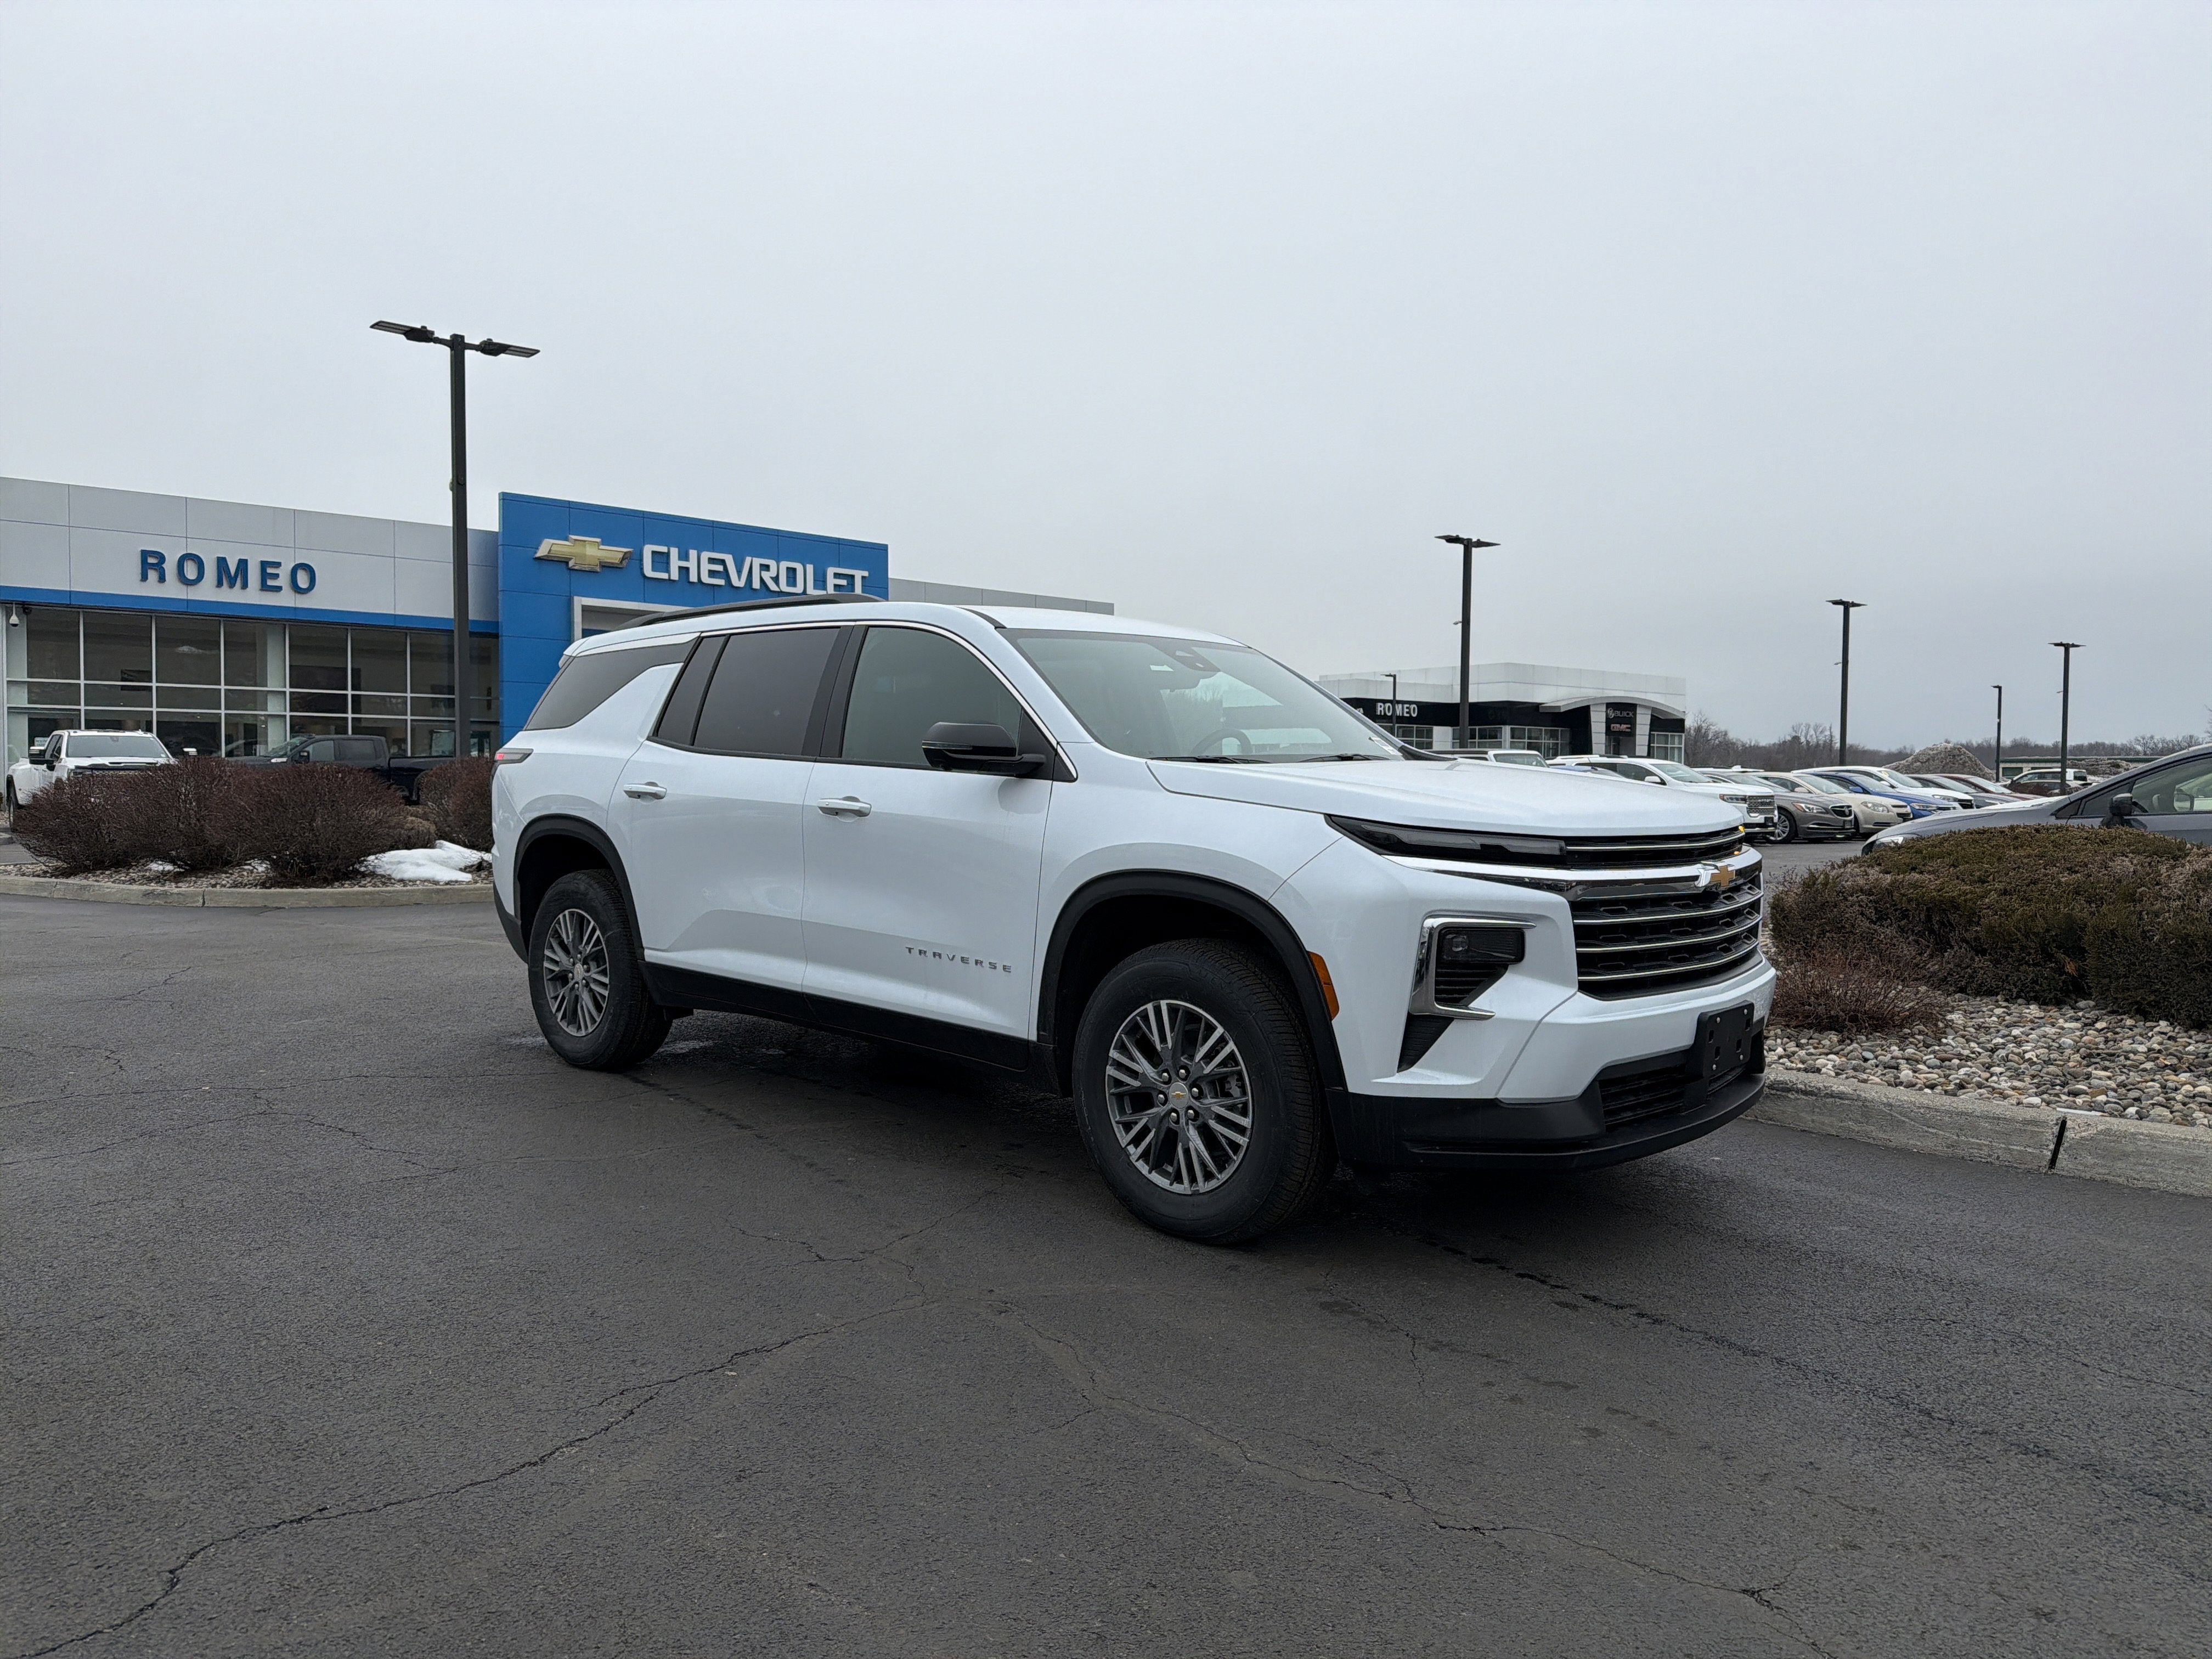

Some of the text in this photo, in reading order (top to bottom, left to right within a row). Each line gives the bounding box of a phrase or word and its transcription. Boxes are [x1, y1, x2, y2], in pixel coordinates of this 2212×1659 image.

[140, 549, 316, 594] ROMEO
[643, 544, 868, 595] CHEVROLET
[1376, 703, 1418, 717] ROMEO
[1611, 724, 1631, 732] GMC
[905, 946, 1012, 973] TRAVERSE
